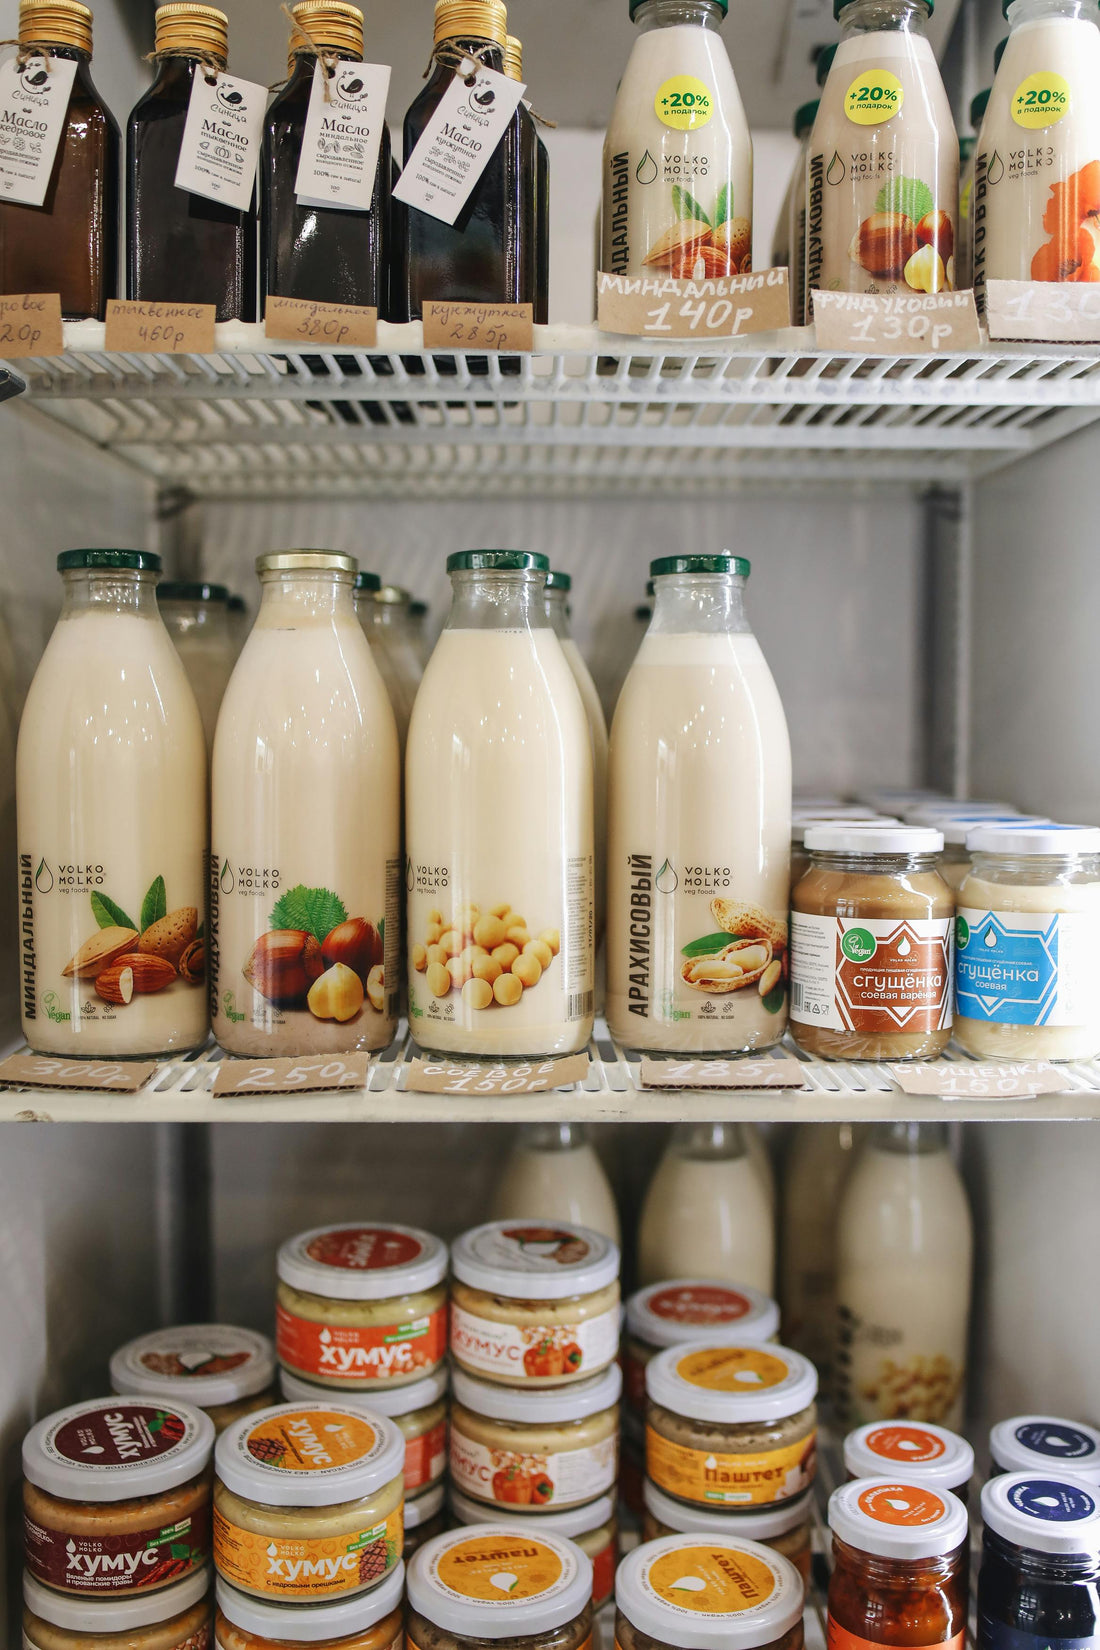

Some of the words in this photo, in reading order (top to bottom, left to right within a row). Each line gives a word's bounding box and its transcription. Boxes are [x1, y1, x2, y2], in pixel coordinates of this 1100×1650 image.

[661, 92, 709, 107] +20%
[850, 87, 898, 102] +20%
[1017, 89, 1066, 106] +20%
[671, 108, 707, 116] подарок
[856, 102, 893, 110] подарок
[1023, 105, 1061, 114] подарок
[1, 110, 48, 132] Масло
[320, 117, 370, 137] Масло
[201, 118, 249, 146] Масло
[319, 131, 369, 145] миндальное
[440, 122, 483, 152] Масло
[436, 135, 477, 160] кунжутное
[1009, 146, 1054, 160] VOLKO
[663, 155, 708, 165] VOLKO
[1009, 158, 1054, 172] MOLKO
[663, 166, 708, 176] MOLKO
[644, 300, 754, 336] 140р
[139, 325, 186, 350] 460р
[297, 319, 351, 343] 380р
[450, 324, 508, 350] 285р
[850, 315, 953, 349] 130р
[58, 865, 103, 874] VOLKO
[238, 867, 280, 878] VOLKO
[416, 865, 449, 876] VOLKO
[684, 866, 731, 876] VOLKO
[58, 876, 103, 885] MOLKO
[238, 879, 280, 889] MOLKO
[416, 876, 449, 887] MOLKO
[684, 878, 731, 887] MOLKO
[19, 854, 36, 1020] МИНДАЛЬНЫЙ
[627, 853, 652, 1018] АРАХИСОВЫЙ
[957, 962, 1039, 982] сгущёнка
[853, 973, 942, 992] сгущёнка
[975, 980, 1007, 991] соевая
[861, 991, 898, 1000] соевая
[21, 1062, 130, 1087] 300р
[236, 1062, 357, 1087] 250р
[423, 1061, 555, 1079] СОЕВОЕ
[660, 1062, 784, 1085] 185р
[319, 1343, 412, 1370] хумус
[103, 1412, 141, 1460] хумус
[290, 1418, 333, 1465] хумус
[320, 1465, 346, 1474] VEGAN
[705, 1467, 784, 1484] Паштет
[66, 1548, 159, 1577] хумус
[453, 1548, 539, 1564] Паштет
[266, 1552, 358, 1582] хумус
[66, 1572, 95, 1581] Вяленые
[96, 1574, 132, 1582] помидоры
[272, 1581, 310, 1589] кедровыми
[311, 1579, 346, 1588] орешками
[711, 1553, 760, 1599] Паштет
